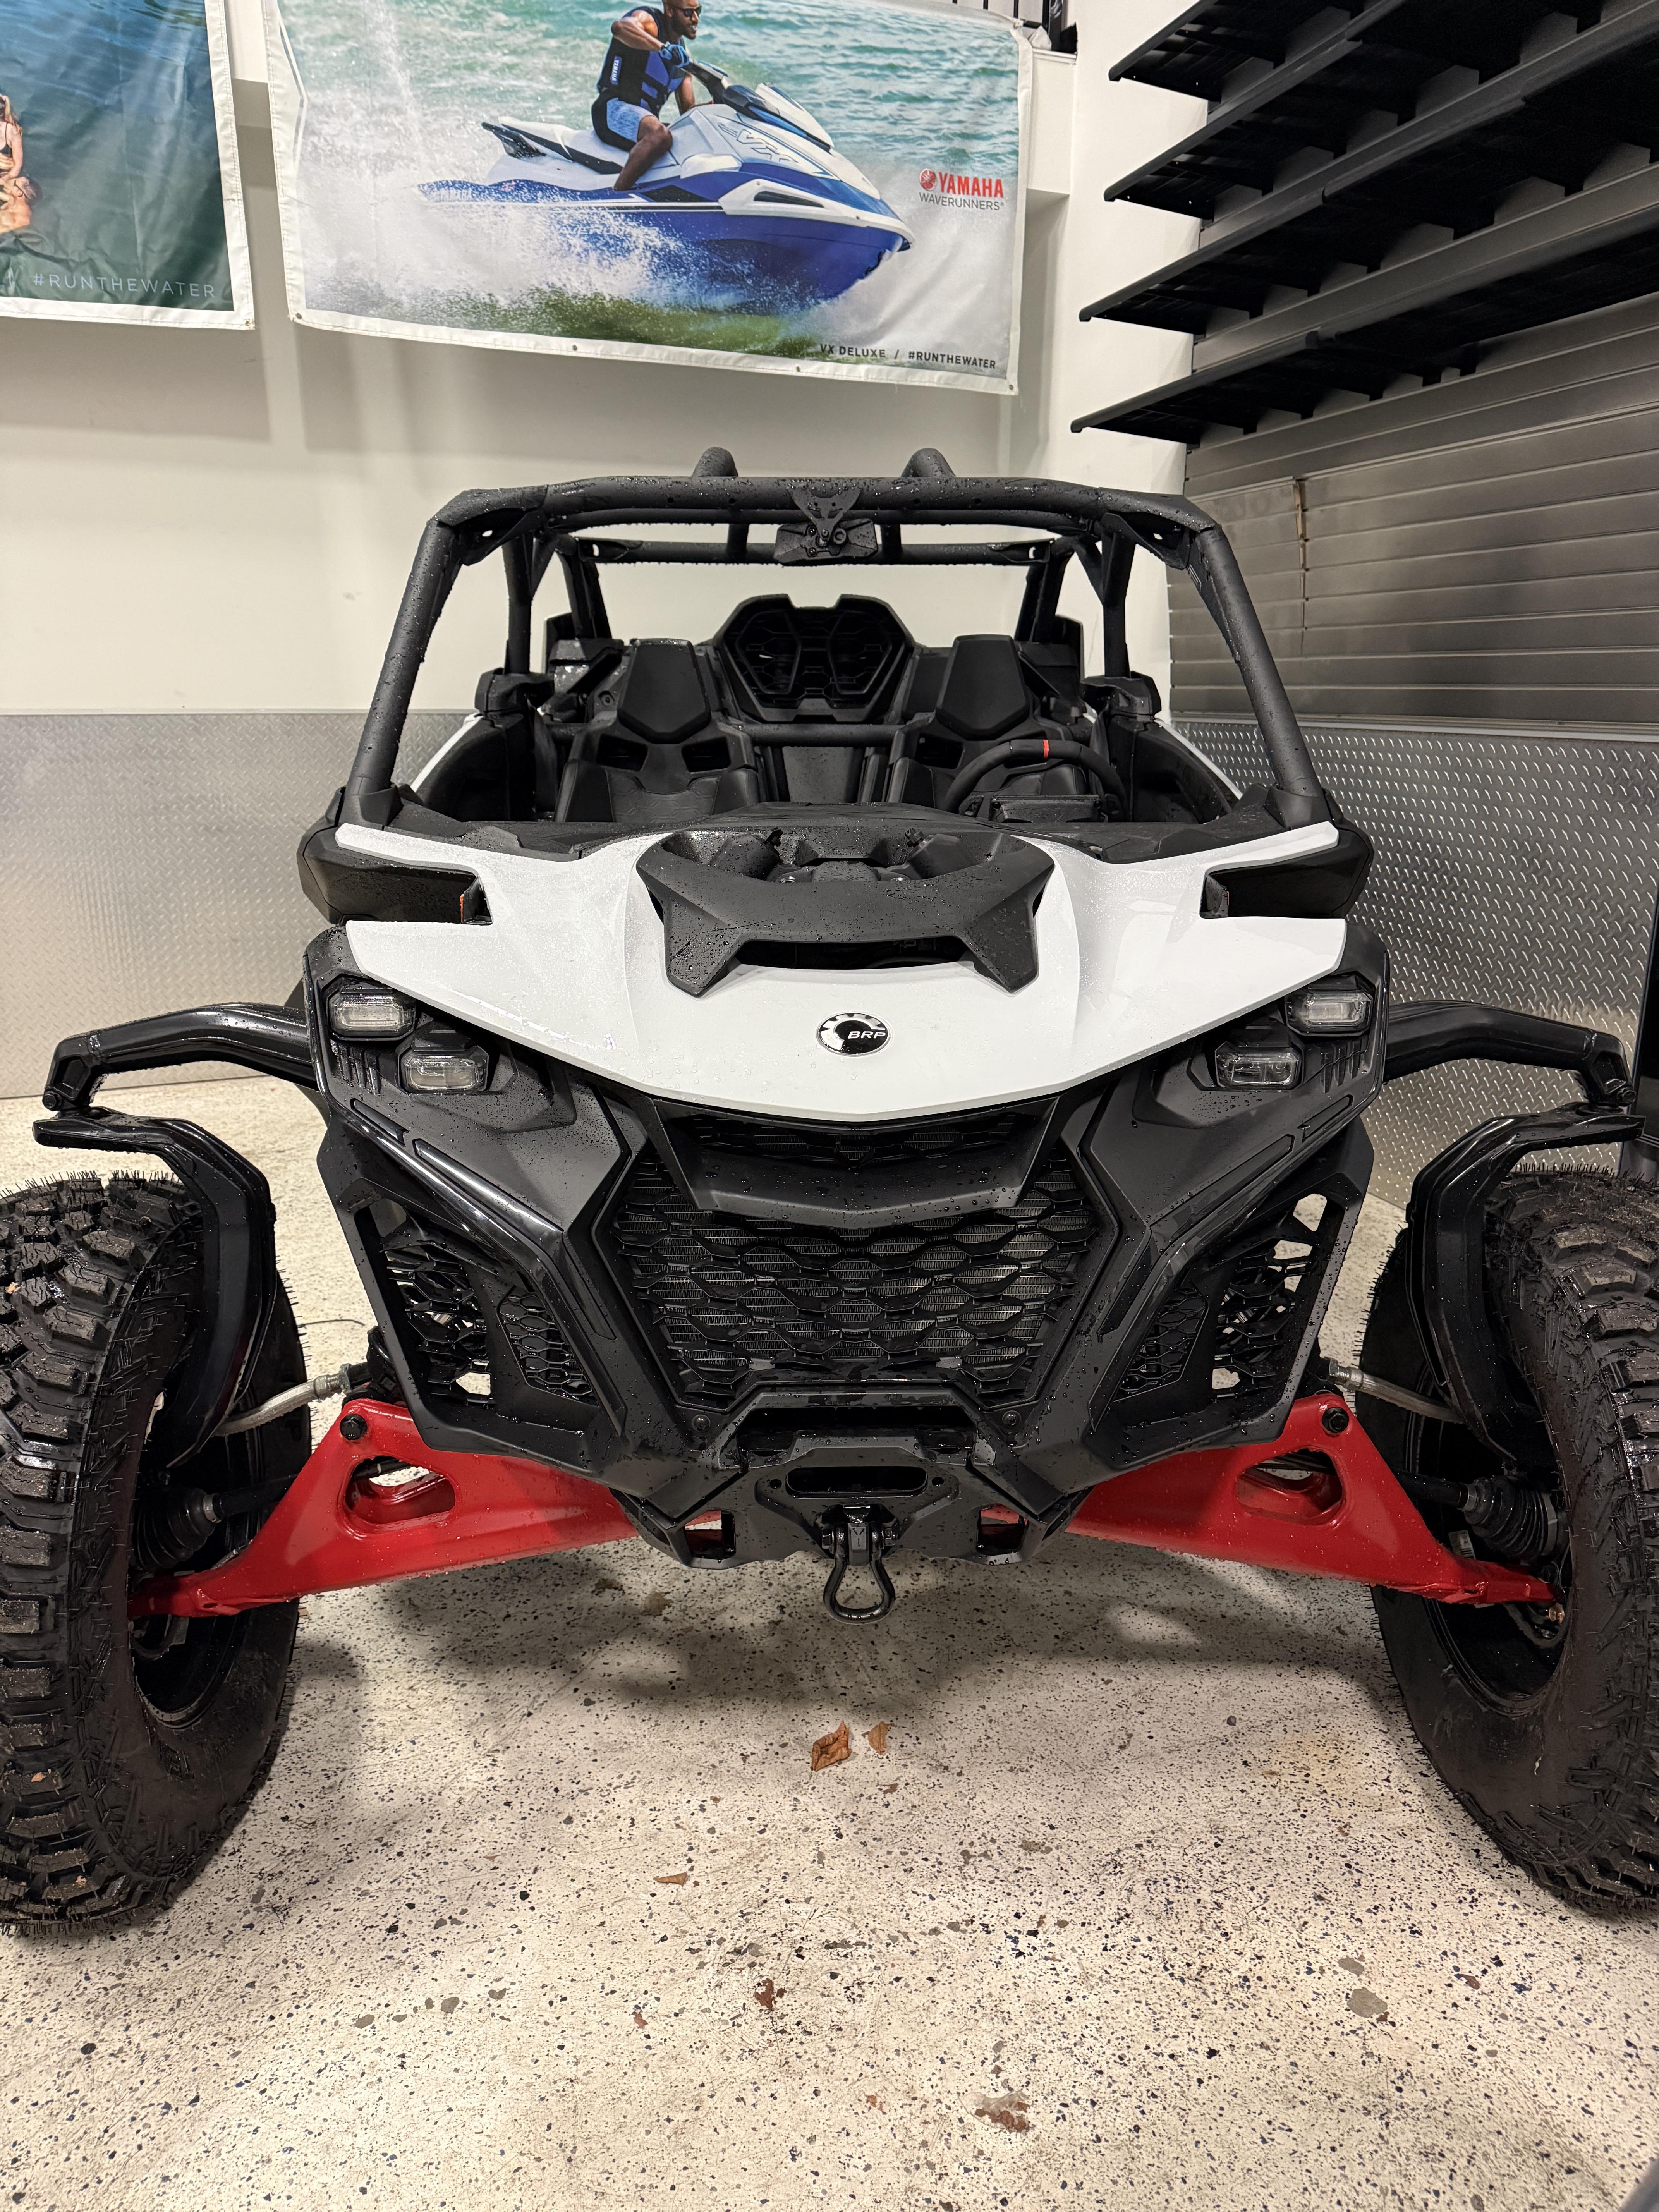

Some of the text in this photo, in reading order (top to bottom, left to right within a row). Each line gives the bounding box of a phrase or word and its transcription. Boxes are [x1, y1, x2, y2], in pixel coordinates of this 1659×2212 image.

[939, 172, 1003, 198] YAMAHA
[34, 273, 214, 297] #RUNTHEWATER
[820, 343, 996, 369] VX DELUXE / #RUNTHEWATER
[847, 1031, 886, 1039] BRP
